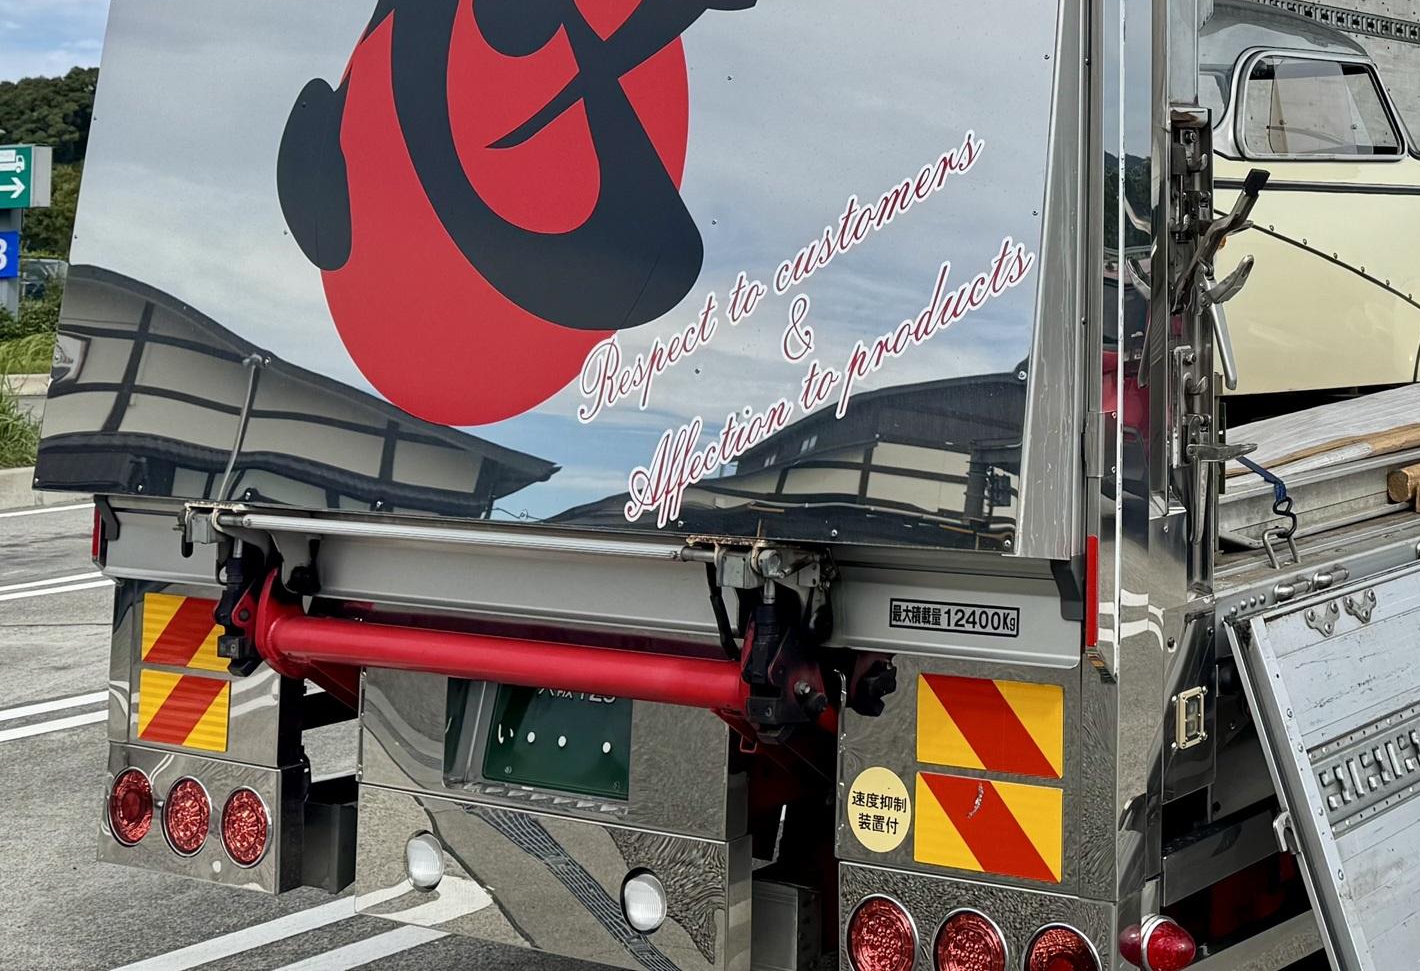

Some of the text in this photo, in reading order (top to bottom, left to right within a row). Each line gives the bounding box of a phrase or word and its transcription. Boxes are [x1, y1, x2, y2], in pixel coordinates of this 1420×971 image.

[579, 131, 983, 421] Respect to customers
[784, 296, 813, 361] &
[626, 237, 1034, 526] Affection to products
[851, 790, 907, 814] 速度抑制
[858, 812, 900, 835] 装置付
